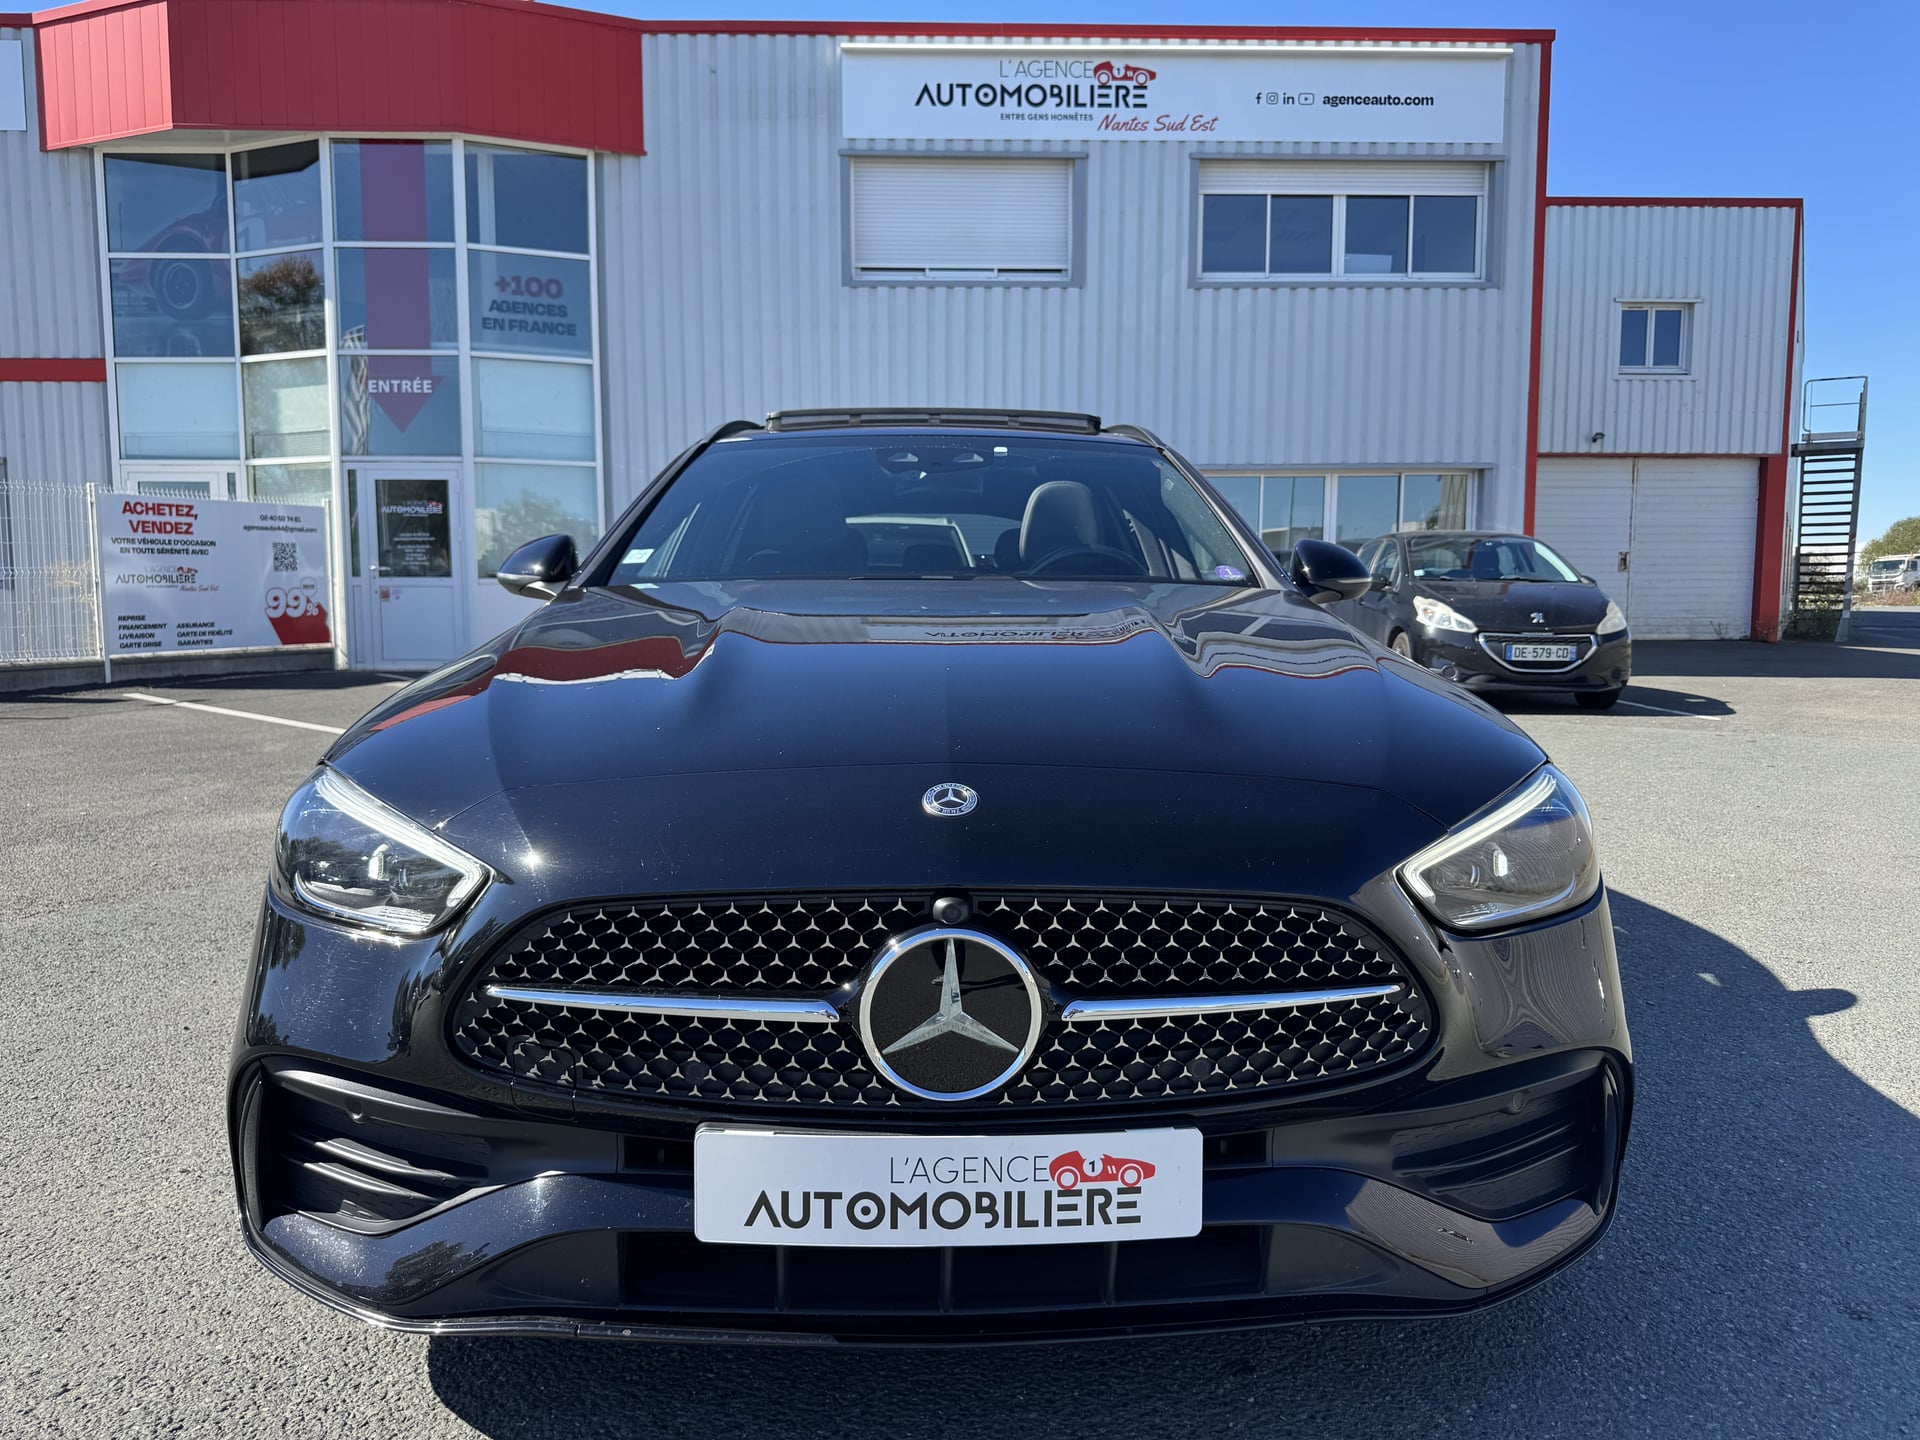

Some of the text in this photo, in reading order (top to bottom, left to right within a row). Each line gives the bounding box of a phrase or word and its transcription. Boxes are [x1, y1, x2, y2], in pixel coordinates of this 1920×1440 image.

[1000, 60, 1093, 79] L'AGENCE
[1322, 93, 1434, 107] agenceauto.com
[1000, 112, 1093, 122] ENTRE GENS HONNÊTES
[1097, 114, 1219, 132] Nantes Sud Est
[495, 276, 564, 299] +100
[488, 300, 568, 318] AGENCES
[481, 317, 577, 336] EN FRANCE
[368, 376, 432, 393] ENTRÉE
[122, 501, 198, 520] ACHETEZ,
[129, 520, 194, 535] VENDEZ
[111, 537, 216, 548] VOTRE VÉHICULE D'OCCASION
[132, 547, 155, 555] TOUTE
[191, 548, 209, 556] AVEC
[119, 623, 167, 631] FINANCEMENT
[177, 630, 197, 638] CARTE
[119, 632, 155, 640] LIVRAISON
[120, 641, 140, 649] CARTE
[1514, 647, 1569, 659] DE-579-CD
[890, 1155, 1049, 1184] L'AGENCE
[1088, 1160, 1096, 1173] 1
